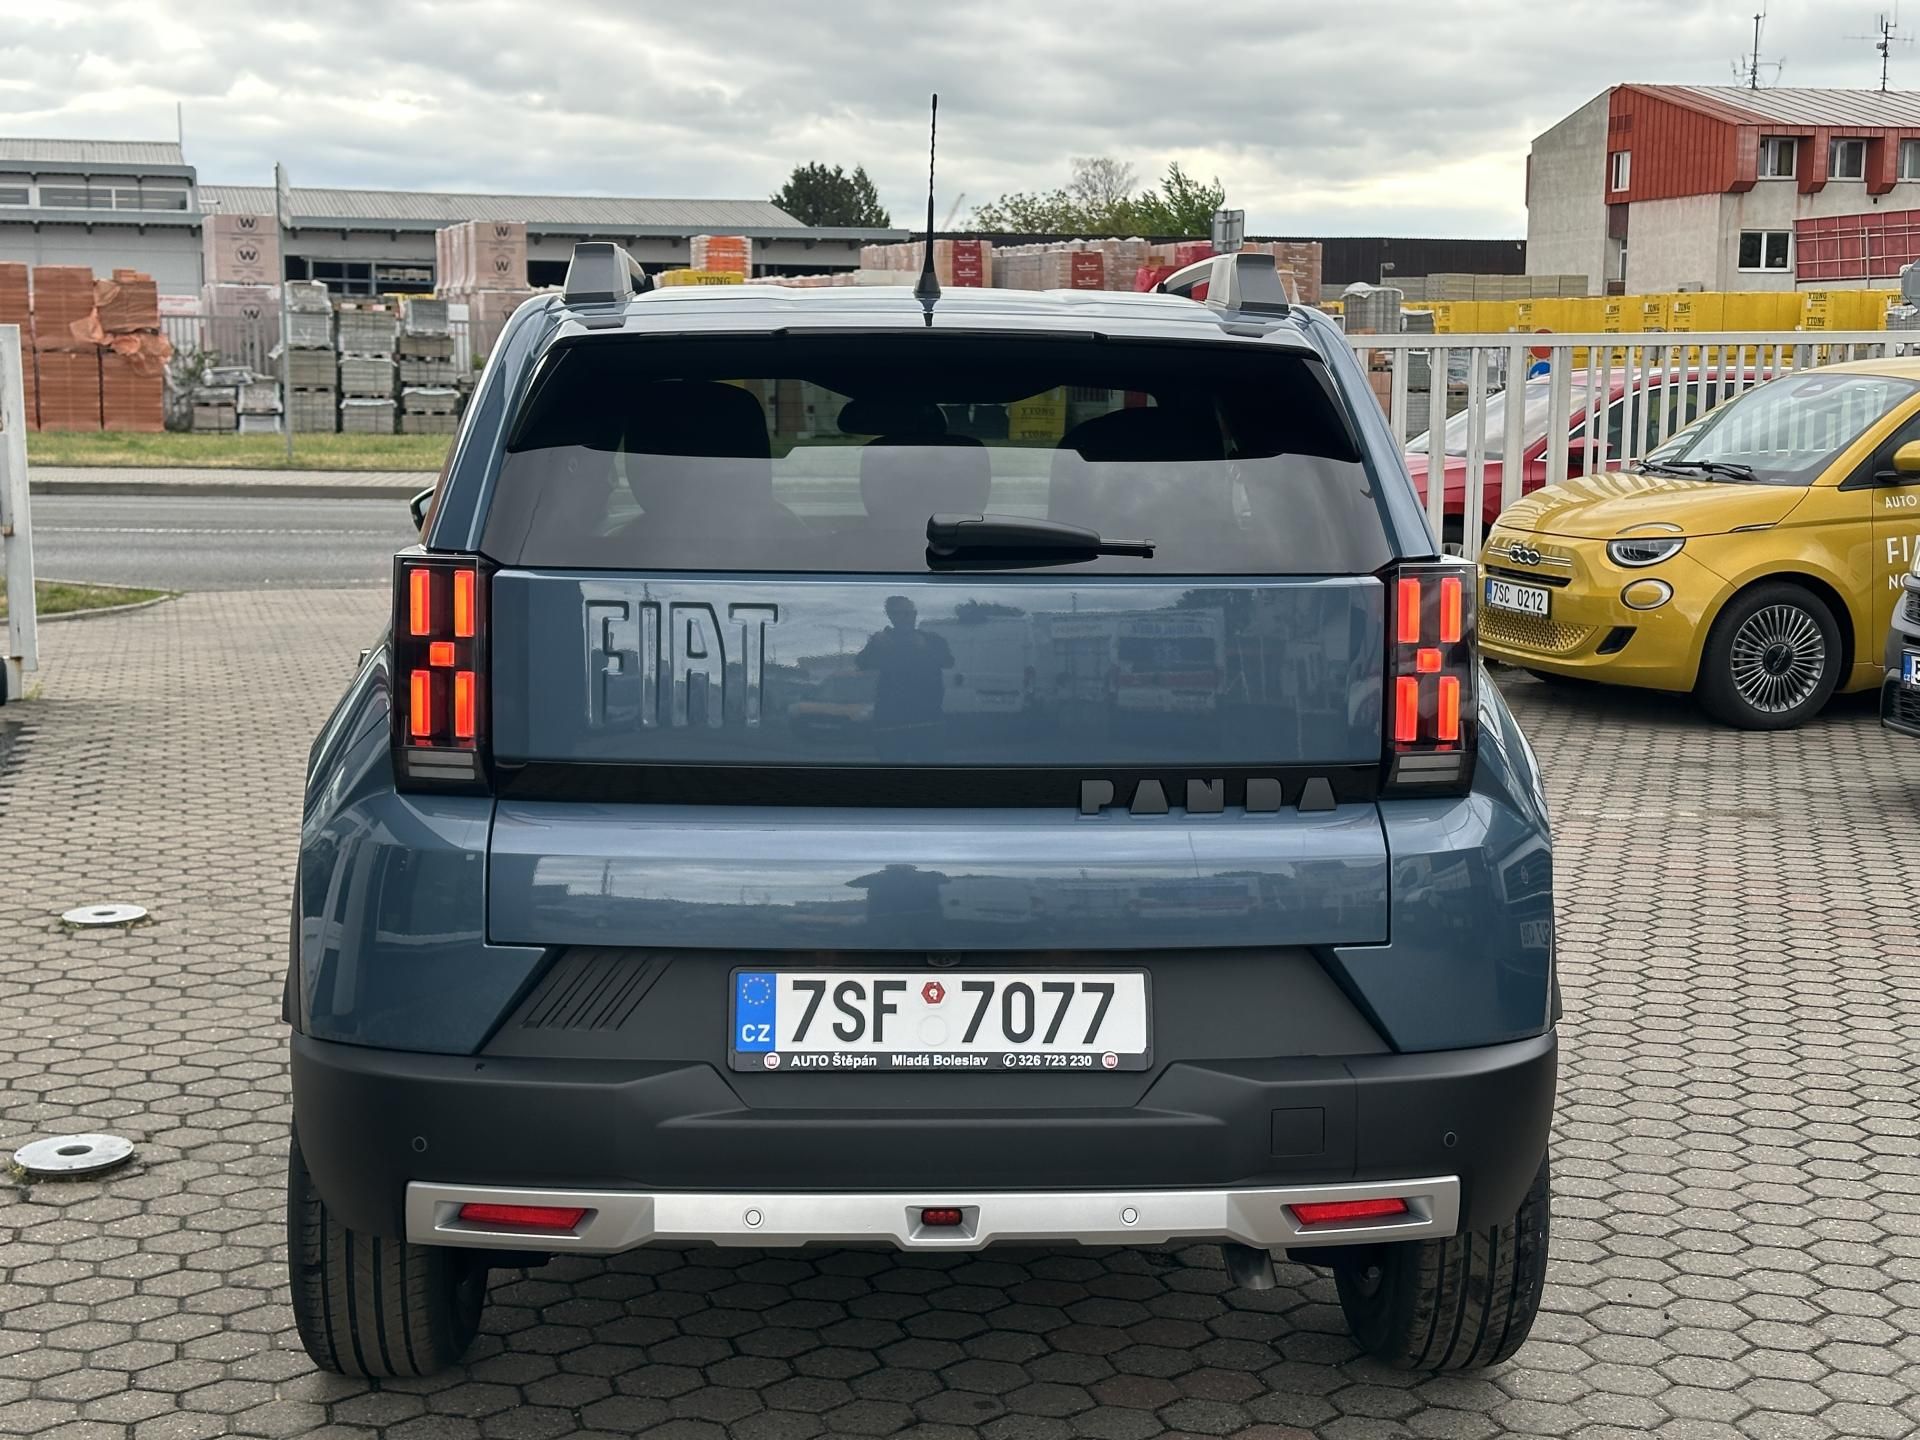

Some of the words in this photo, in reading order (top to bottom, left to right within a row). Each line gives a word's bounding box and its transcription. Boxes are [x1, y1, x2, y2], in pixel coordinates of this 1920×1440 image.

[240, 250, 256, 260] W
[496, 261, 509, 271] W
[696, 276, 730, 285] YTONG
[1885, 495, 1917, 508] AUTO
[1493, 582, 1510, 604] 7SC
[1517, 588, 1544, 612] 0212
[585, 600, 779, 728] FIAT
[1080, 777, 1337, 815] PANDA
[792, 980, 907, 1042] 7SF
[962, 981, 1115, 1044] 7077
[742, 1024, 770, 1042] CZ
[791, 1055, 829, 1067] AUTO
[832, 1052, 877, 1068] Štěpán
[891, 1053, 930, 1067] Mladá
[933, 1054, 988, 1067] Boleslav
[1018, 1054, 1041, 1066] 326
[1044, 1054, 1067, 1066] 723
[1070, 1055, 1093, 1067] 230
